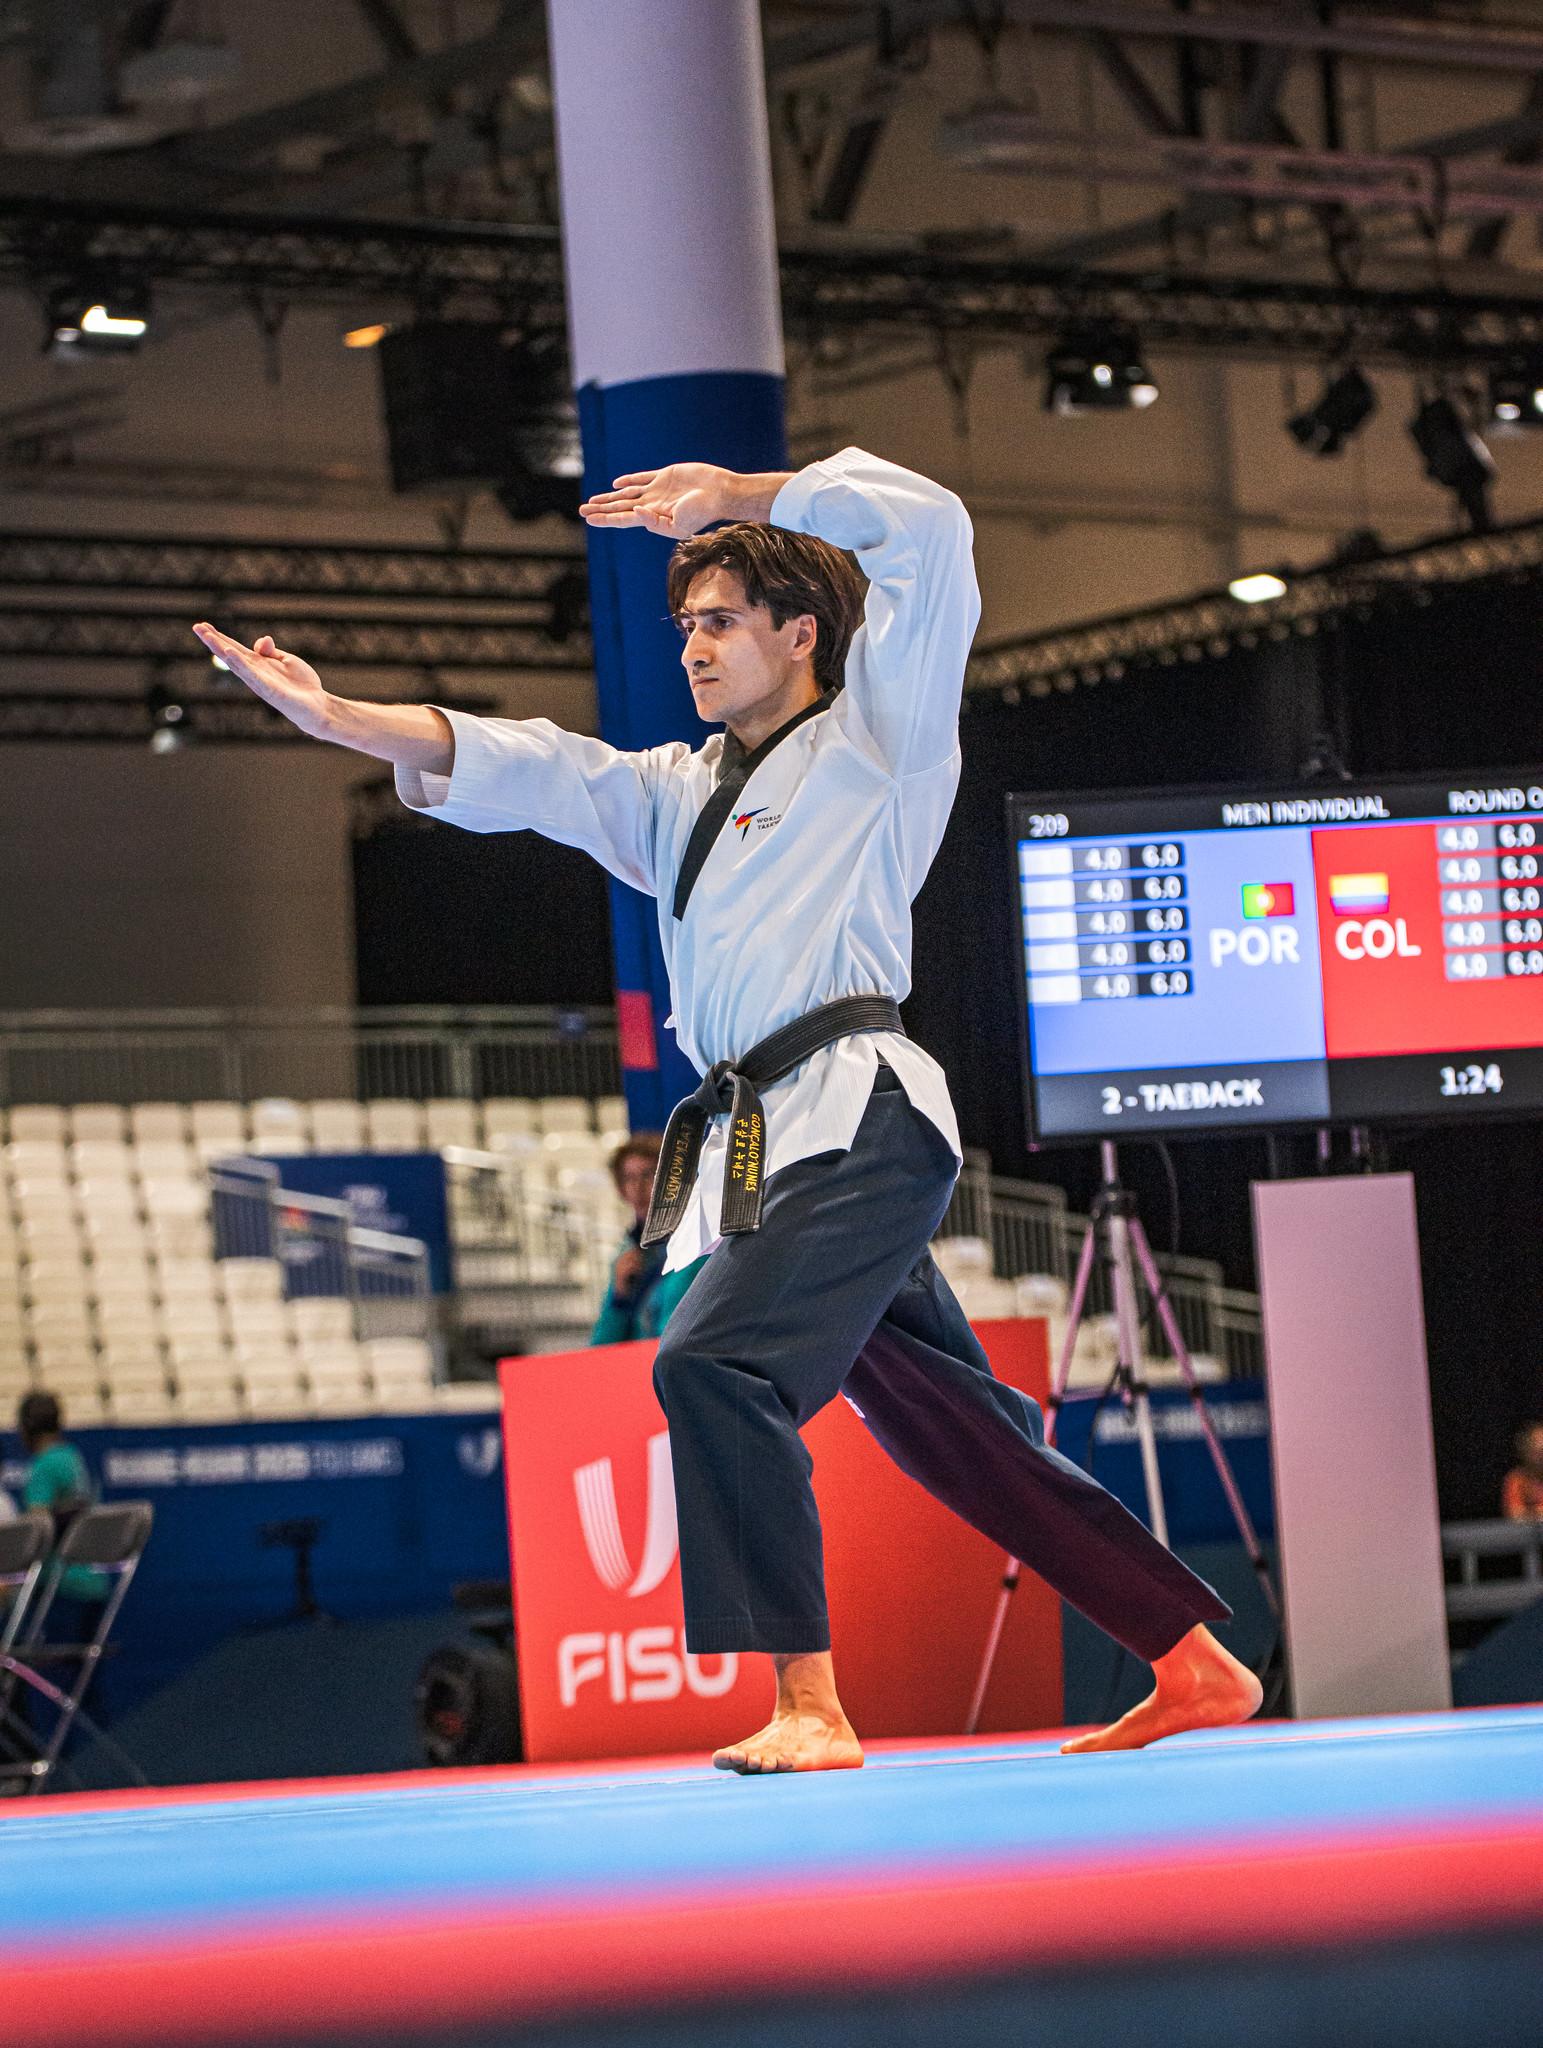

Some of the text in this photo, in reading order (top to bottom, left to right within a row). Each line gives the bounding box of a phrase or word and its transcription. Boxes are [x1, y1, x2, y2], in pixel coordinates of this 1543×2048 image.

[1222, 795, 1390, 826] MEN INDIVIDUAL
[1449, 788, 1526, 814] ROUND
[756, 814, 782, 824] WORLD
[757, 819, 781, 830] TAEKW
[1029, 813, 1069, 837] 209
[1442, 823, 1536, 850] 4.0 6.0
[1085, 844, 1179, 870] 4.0 6.0
[1445, 855, 1538, 882] 4.0 6.0
[1087, 875, 1181, 902] 4.0 6.0
[1447, 886, 1540, 914] 4.0 6.0
[1089, 907, 1183, 934] 4.0 6.0
[1449, 918, 1542, 945] 4.0 6.0
[1091, 939, 1185, 966] 4.0 6.0
[1209, 924, 1300, 967] POR
[1335, 918, 1422, 960] COL
[1451, 950, 1543, 978] 4.0 6.0
[1093, 971, 1188, 998] 4.0 6.0
[1440, 1063, 1504, 1096] 1:24
[1101, 1086, 1123, 1115] 2
[1138, 1078, 1264, 1112] TAEBACK
[745, 1113, 761, 1192] GONÇALO NUNES
[557, 1625, 739, 1708] FISU
